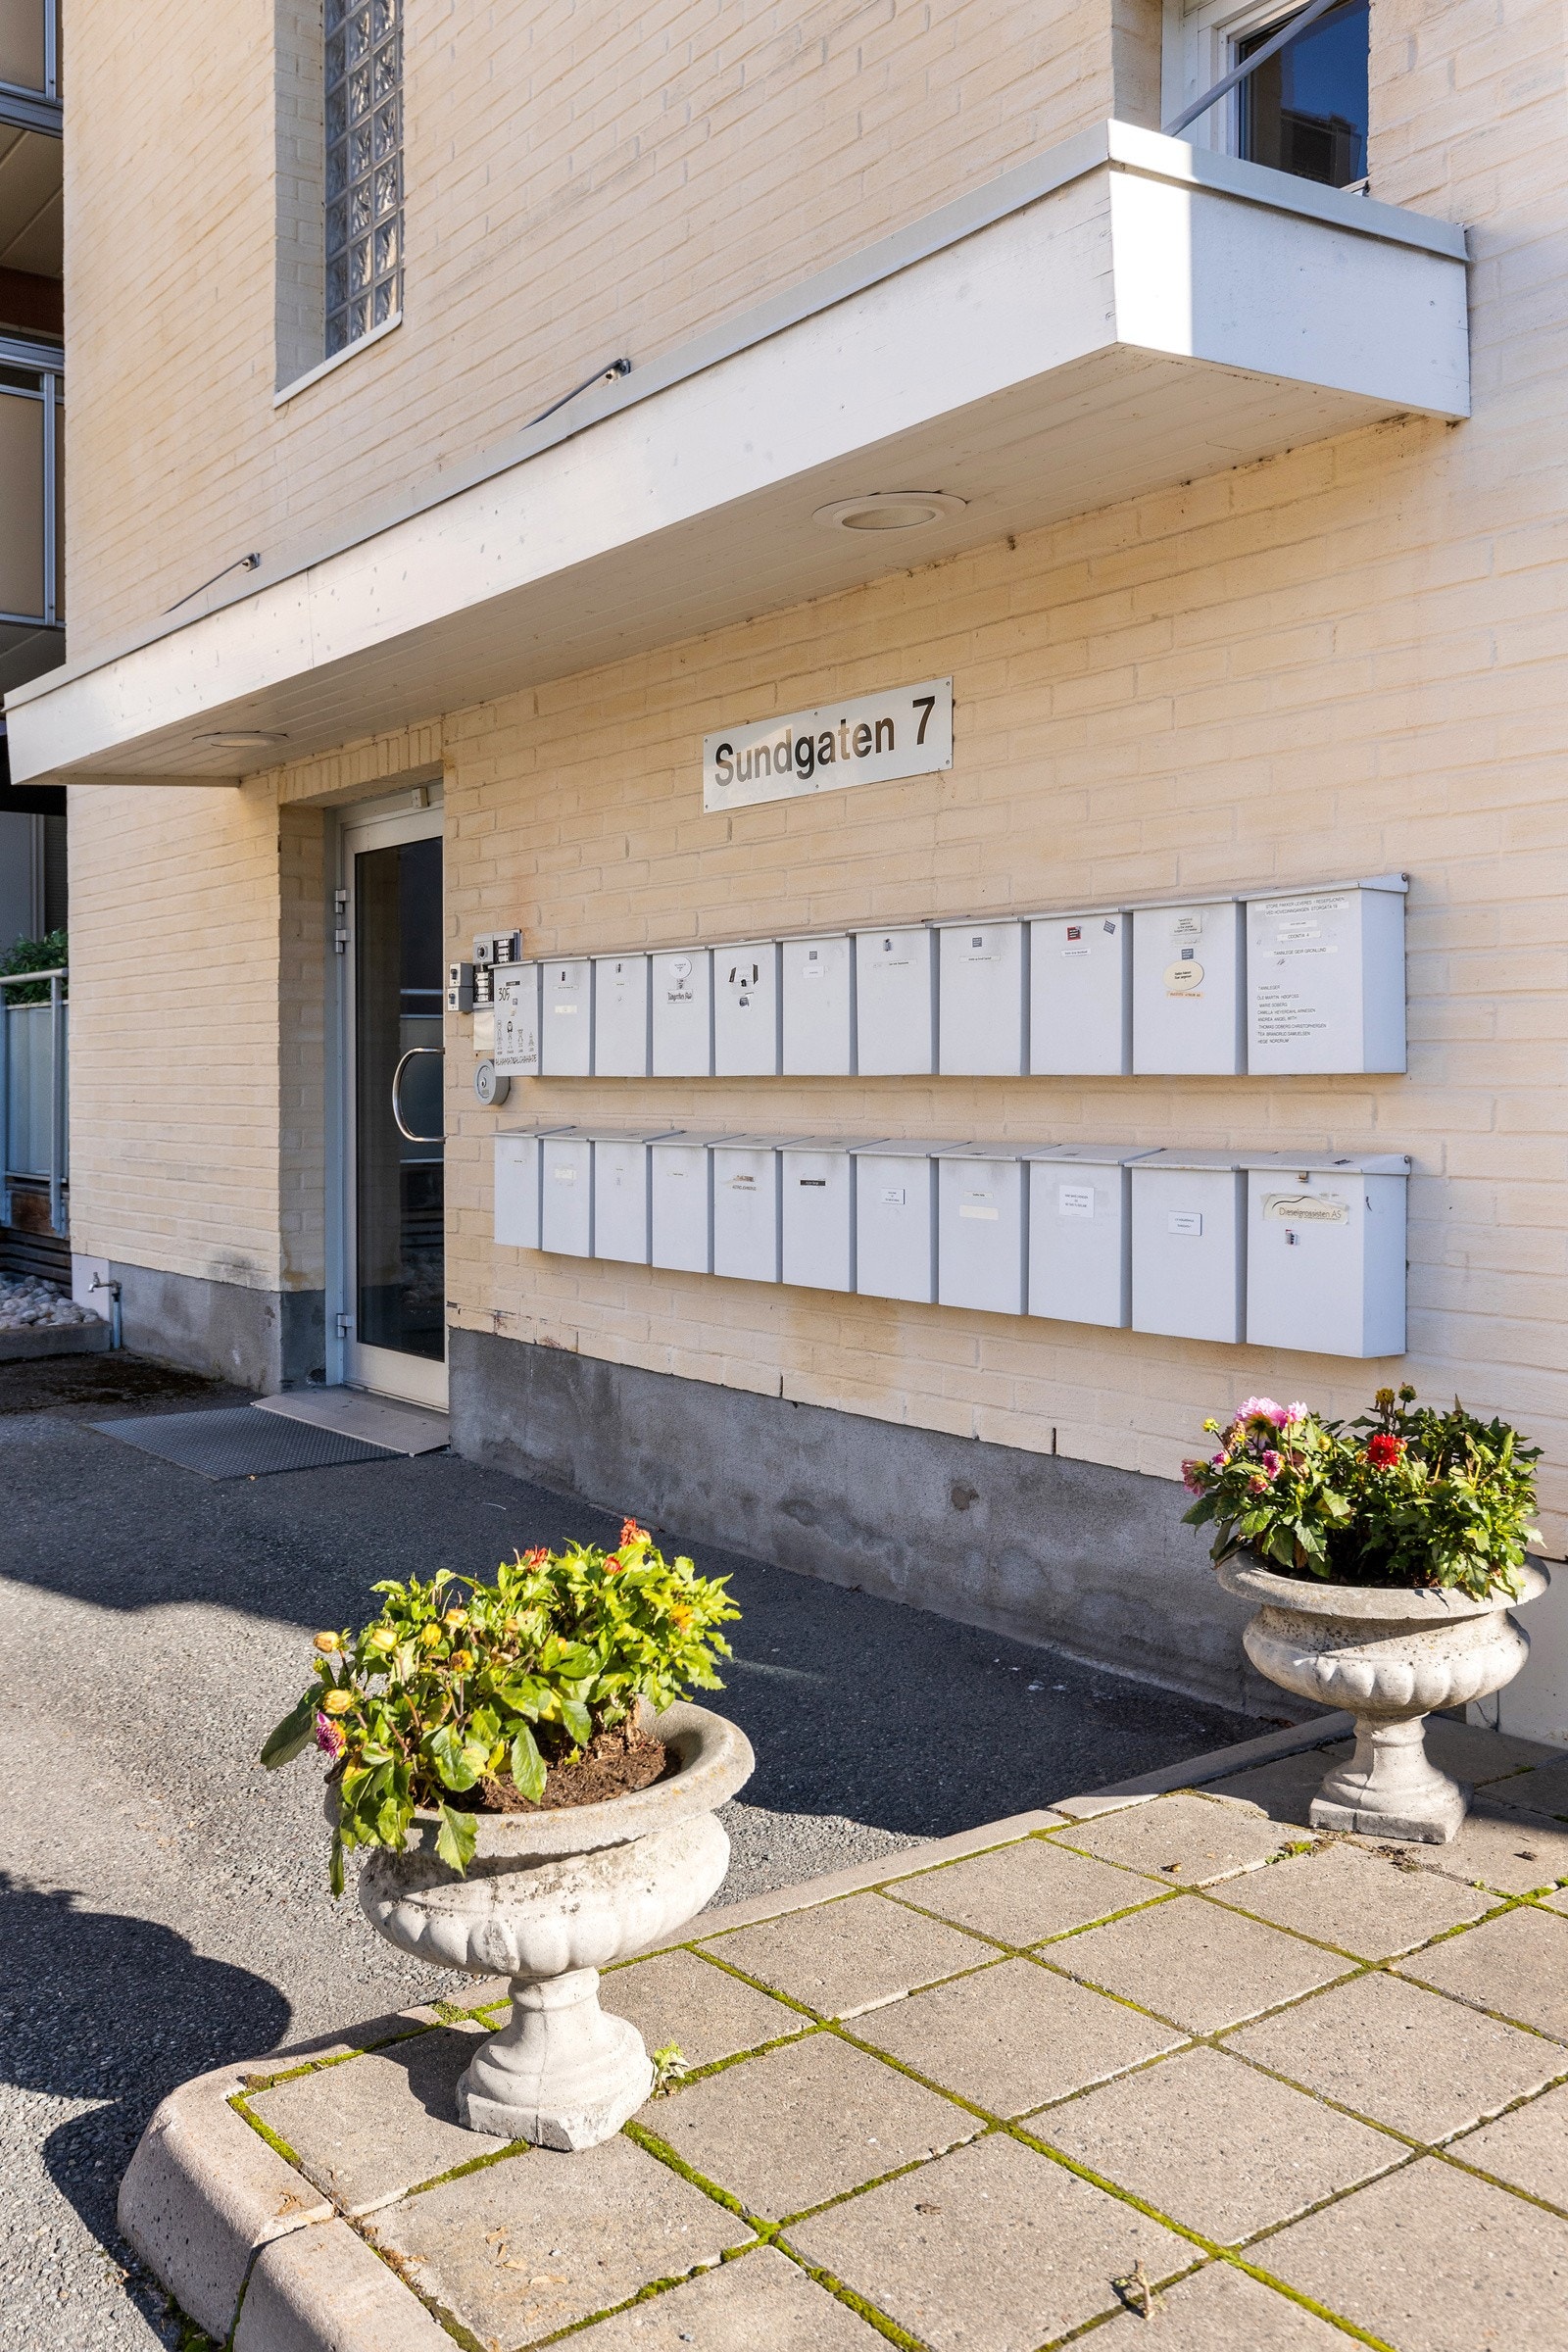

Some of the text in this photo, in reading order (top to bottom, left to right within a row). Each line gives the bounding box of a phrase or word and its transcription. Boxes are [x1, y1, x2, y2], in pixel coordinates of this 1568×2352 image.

[714, 695, 936, 787] Sundgaten 7
[498, 987, 511, 1002] 305
[1279, 1206, 1330, 1219] Dieselgrossisten
[1331, 1209, 1342, 1219] AS
